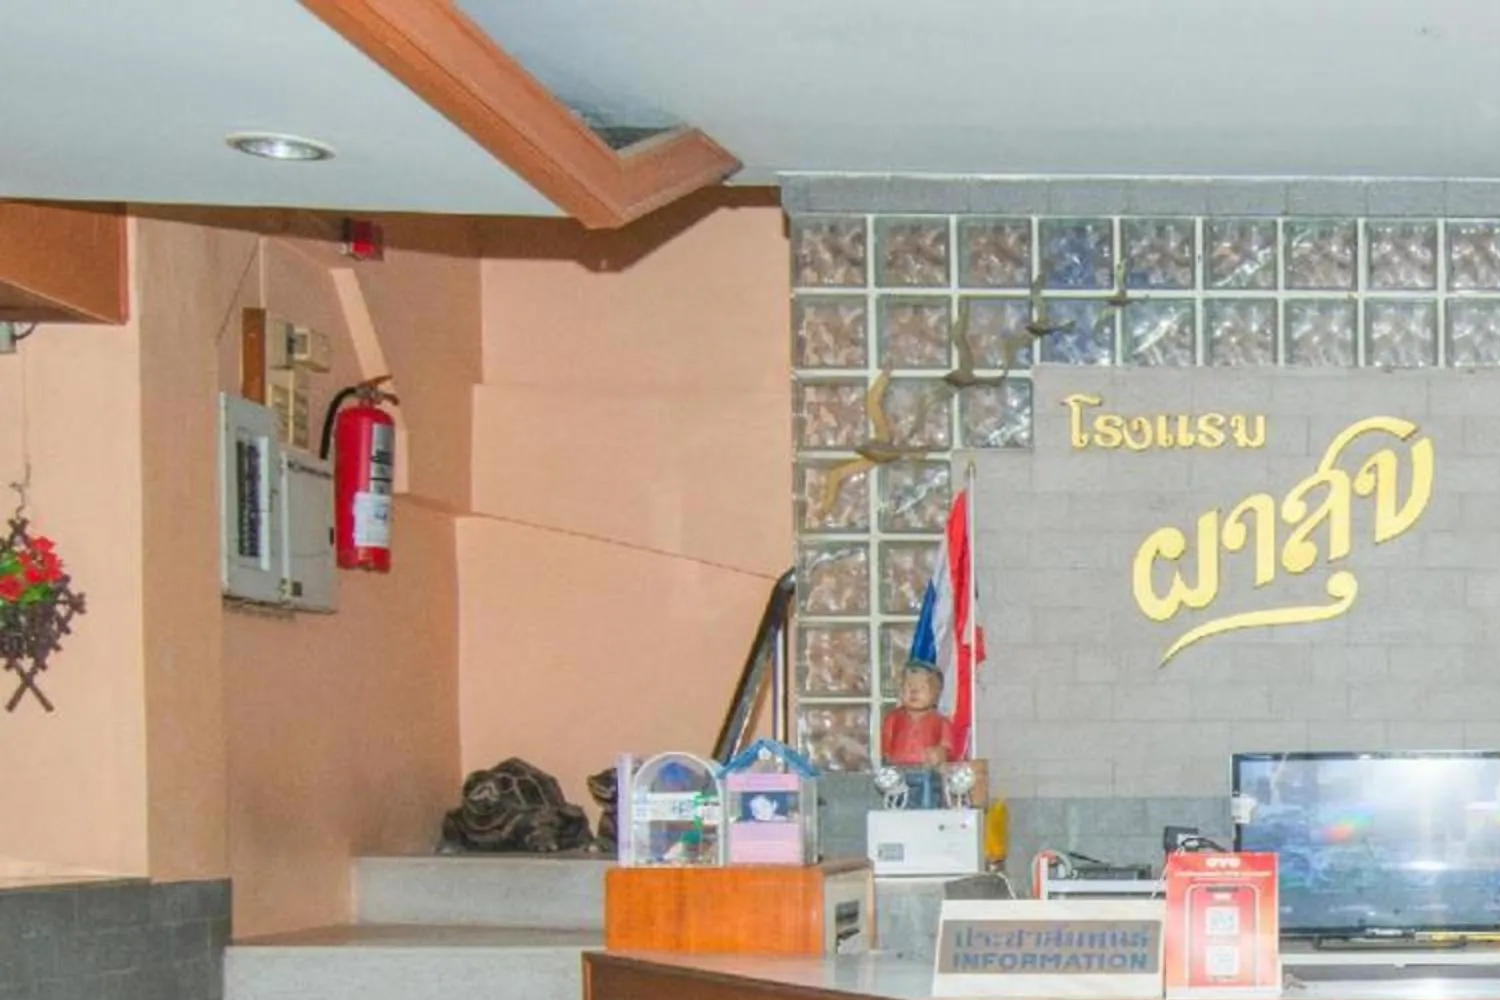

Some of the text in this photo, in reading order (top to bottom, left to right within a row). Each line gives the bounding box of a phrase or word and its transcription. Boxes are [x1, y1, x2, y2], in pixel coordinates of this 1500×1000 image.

[1061, 393, 1267, 451] โรงแรม
[1132, 415, 1434, 668] ผาสุข
[953, 952, 1149, 971] INFORMATION
